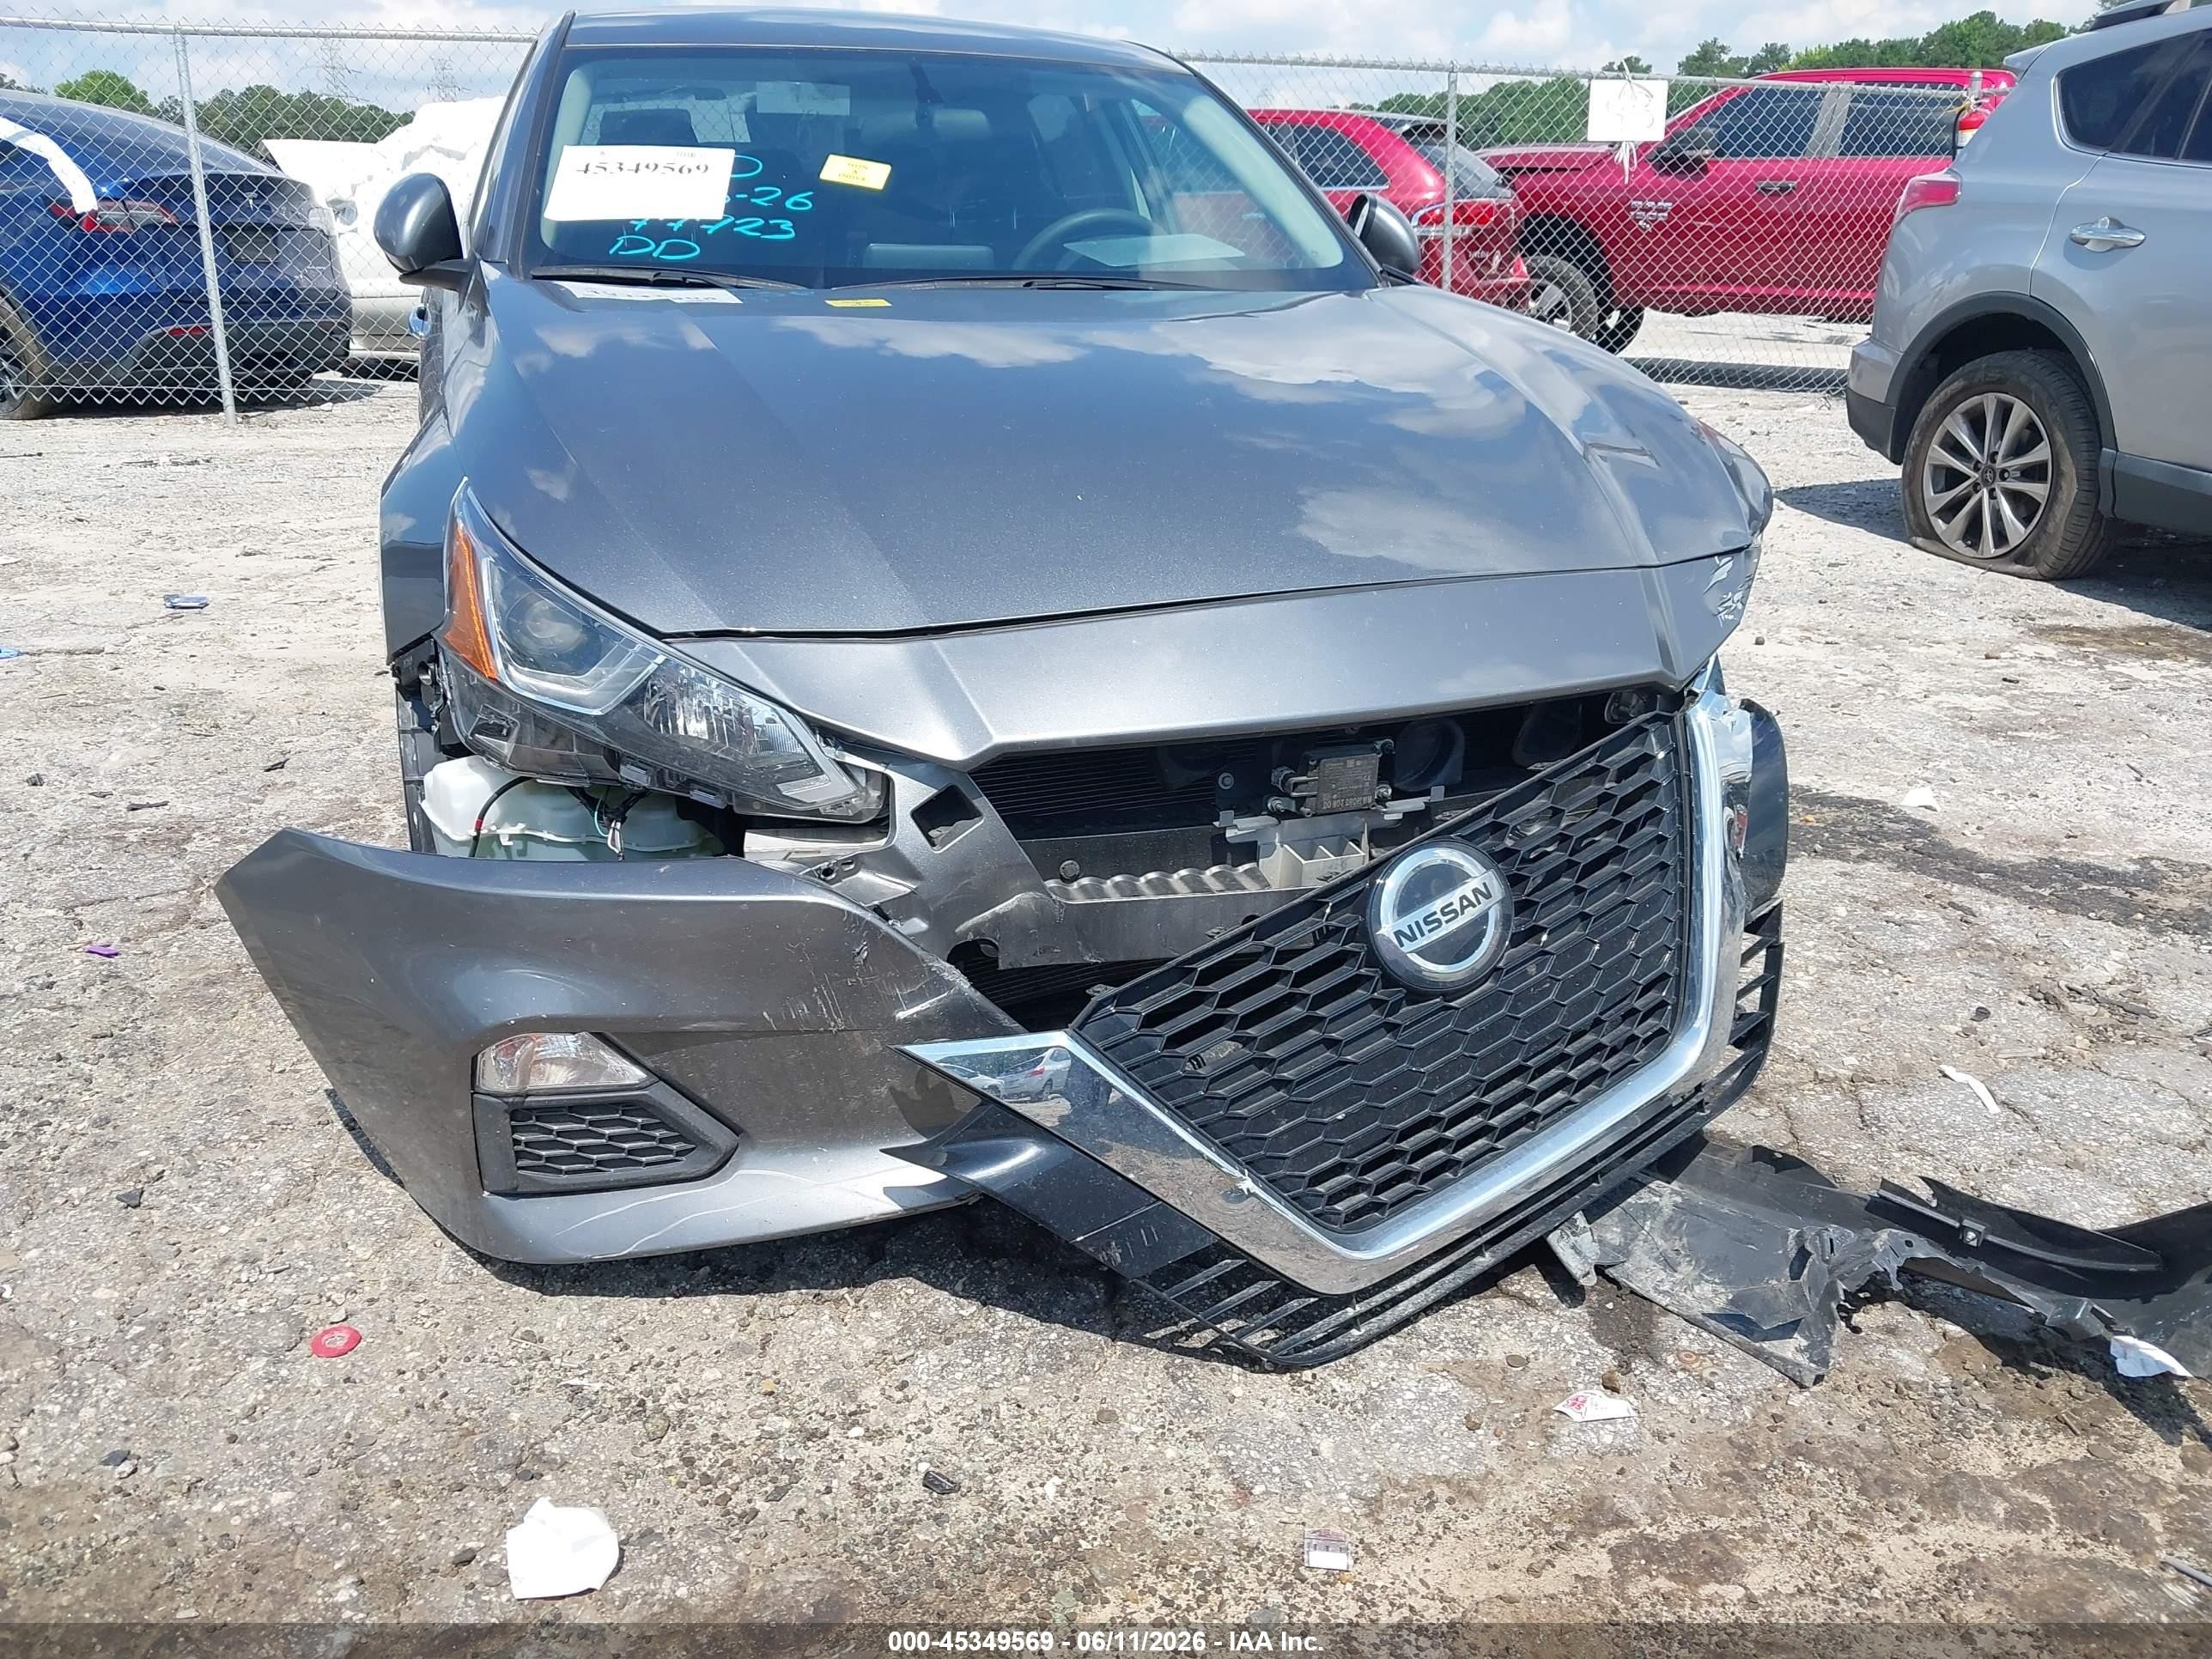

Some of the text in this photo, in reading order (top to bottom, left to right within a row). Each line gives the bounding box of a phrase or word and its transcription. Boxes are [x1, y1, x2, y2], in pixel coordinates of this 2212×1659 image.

[576, 161, 709, 174] 45349569
[609, 234, 701, 259] DD
[1393, 881, 1493, 949] NISSAN
